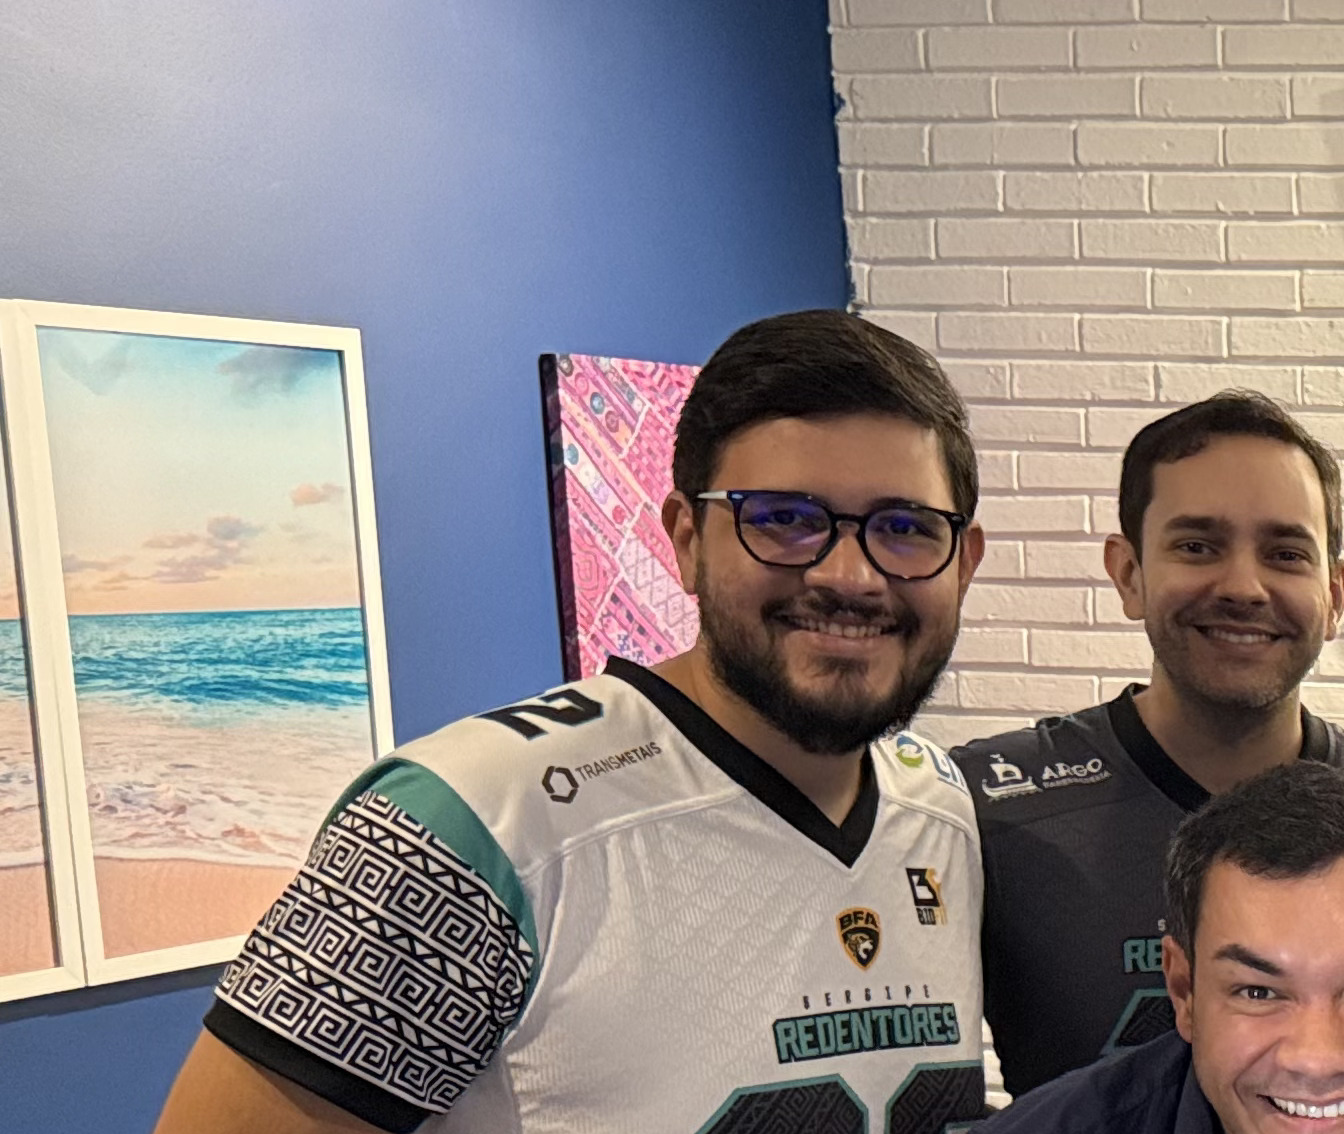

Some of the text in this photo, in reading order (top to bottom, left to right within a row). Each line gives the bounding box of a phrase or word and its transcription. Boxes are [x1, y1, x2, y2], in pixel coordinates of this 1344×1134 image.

[576, 742, 662, 782] TRANSMETAIS
[1042, 758, 1102, 780] ARGO
[838, 910, 879, 931] BFA
[802, 984, 930, 1010] SERGIPE
[773, 1004, 961, 1063] REDENTORES
